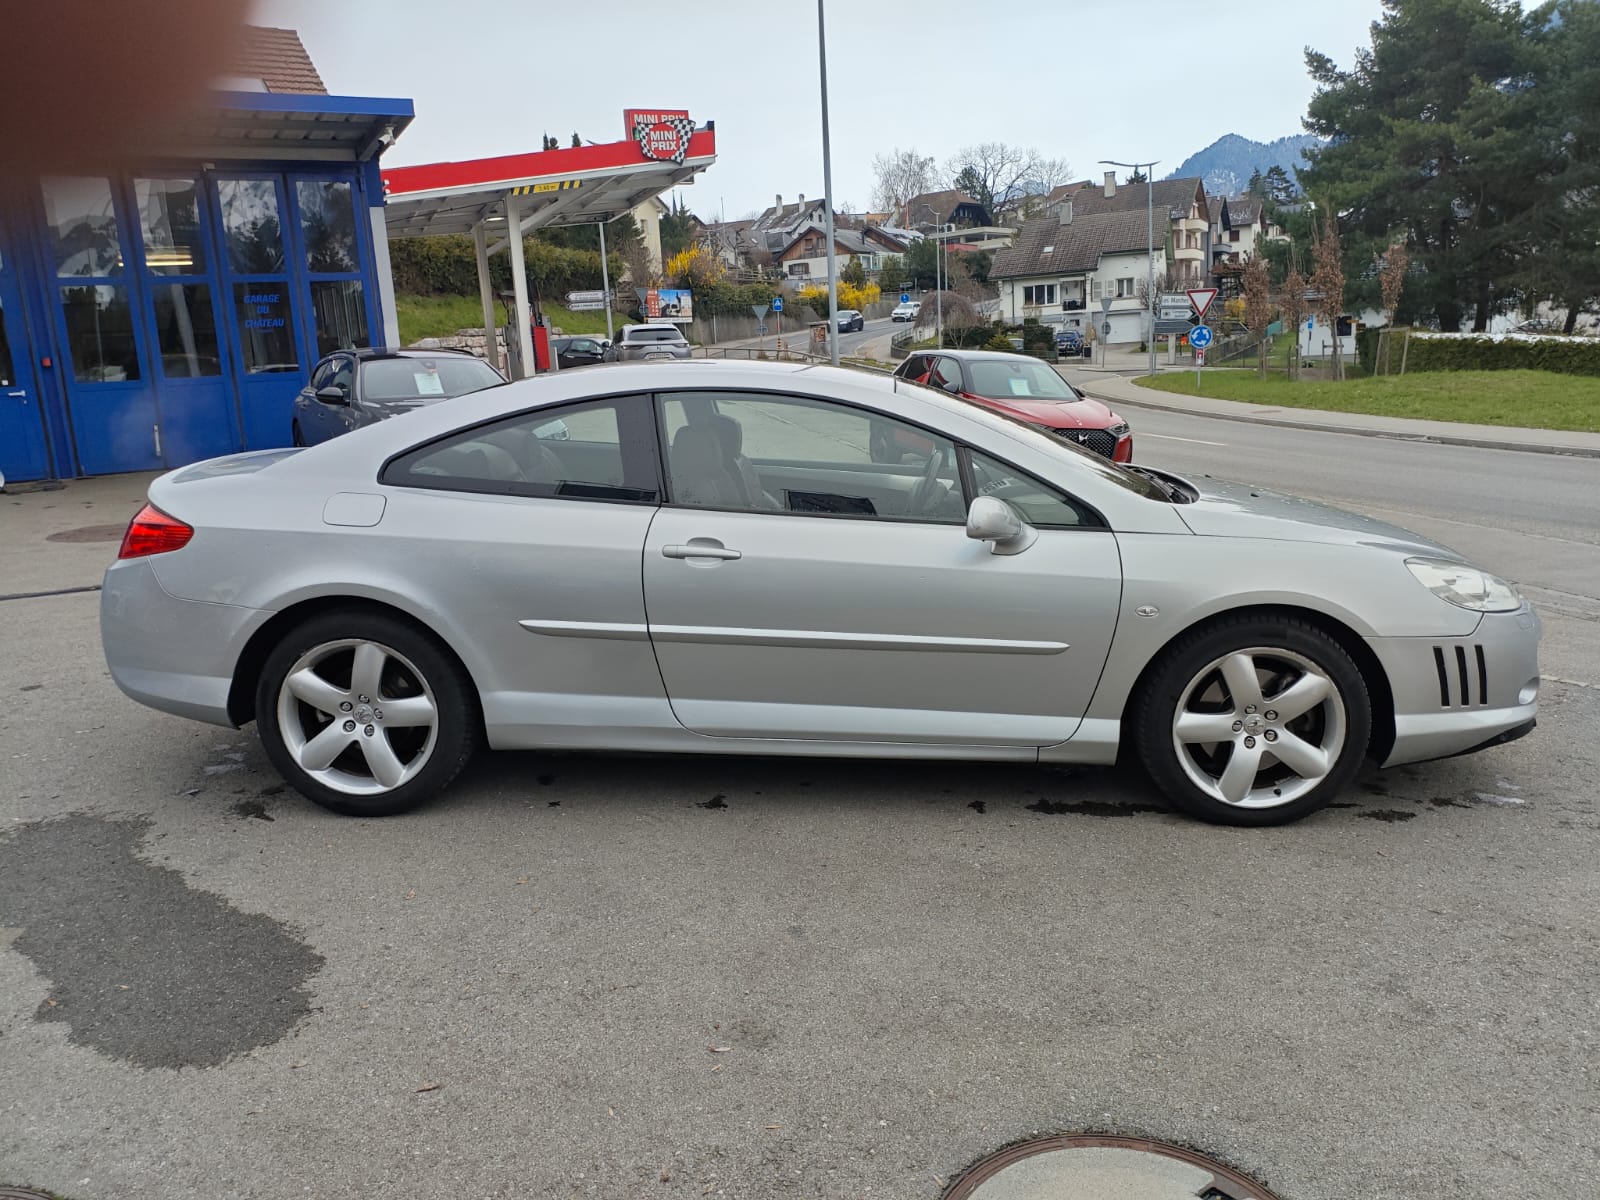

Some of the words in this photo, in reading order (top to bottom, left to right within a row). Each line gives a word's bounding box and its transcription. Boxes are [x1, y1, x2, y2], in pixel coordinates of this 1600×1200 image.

[634, 114, 658, 123] MINI
[650, 131, 676, 140] MINI
[651, 141, 677, 151] PRIX
[244, 295, 280, 303] GARAGE
[257, 306, 270, 314] DU
